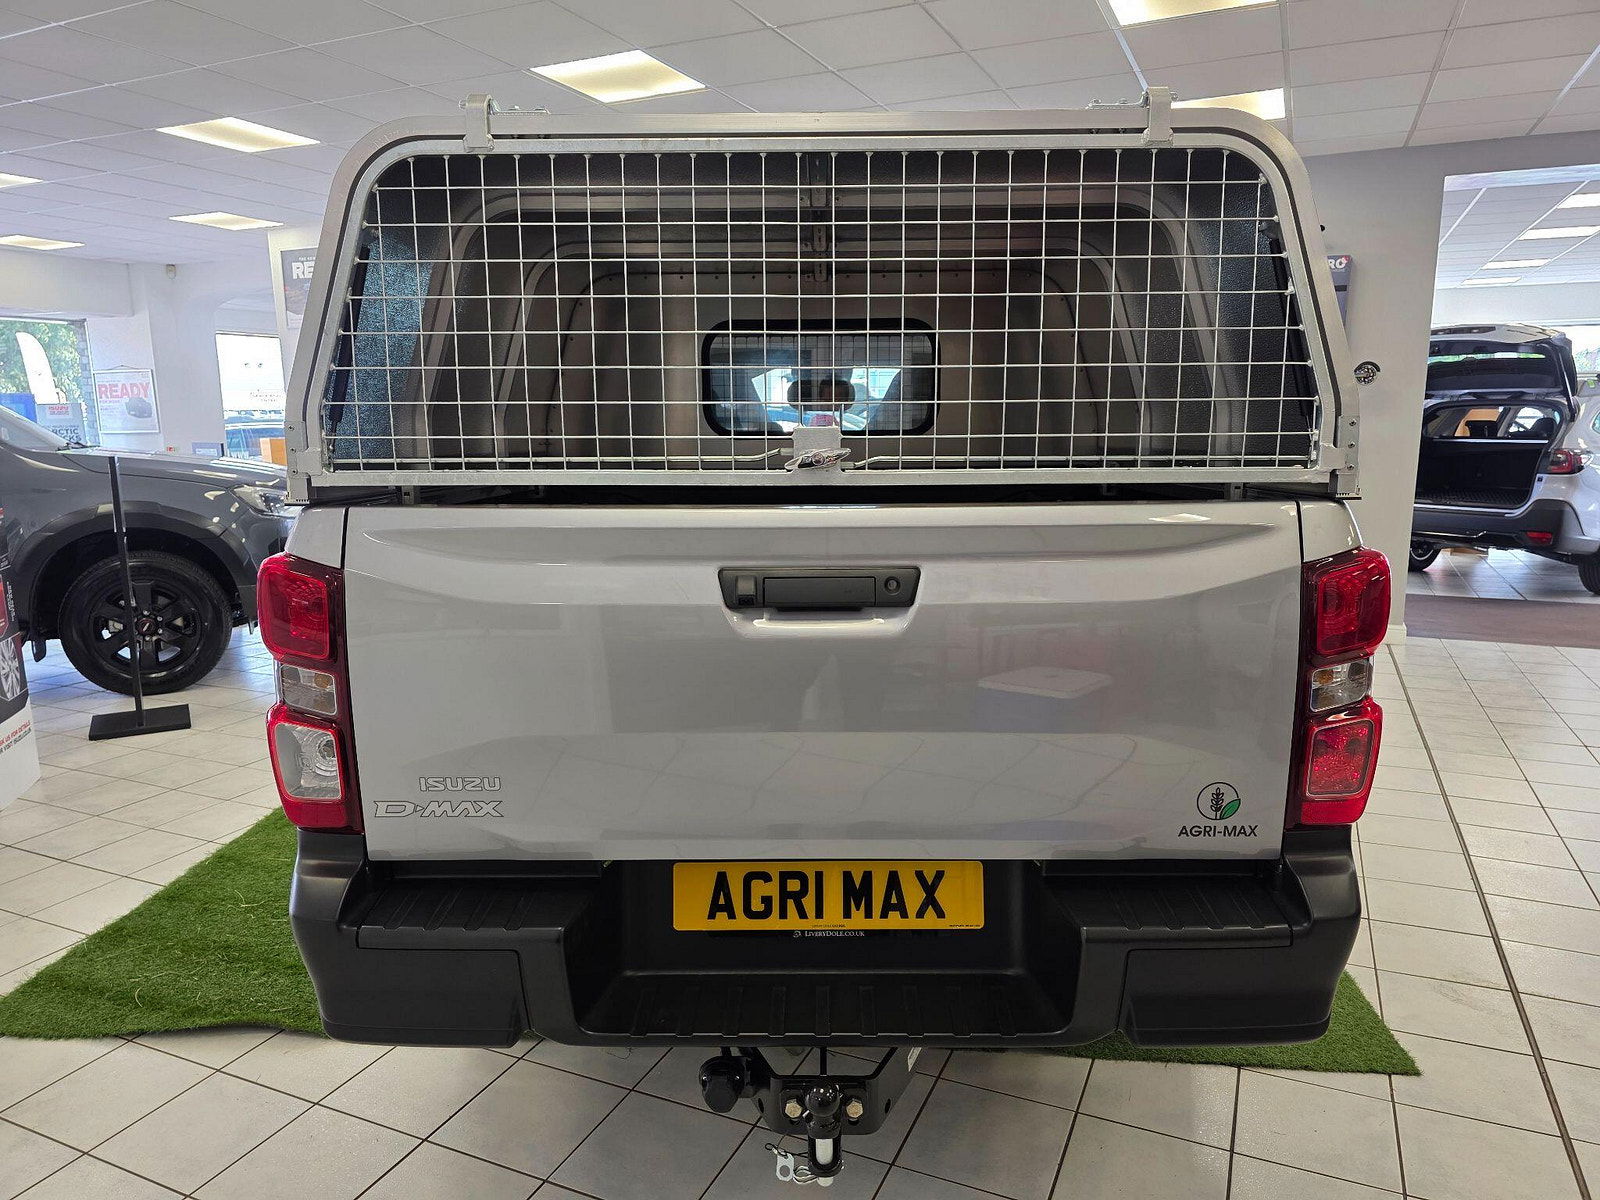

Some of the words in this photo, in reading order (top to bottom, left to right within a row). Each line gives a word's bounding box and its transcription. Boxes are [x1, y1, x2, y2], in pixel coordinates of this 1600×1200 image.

[291, 261, 315, 280] RE
[1327, 257, 1346, 270] RO
[97, 382, 150, 400] READY
[419, 777, 501, 792] ISUZU
[1178, 825, 1259, 838] AGRI-MAX
[707, 870, 824, 920] AGRI
[842, 870, 946, 920] MAX
